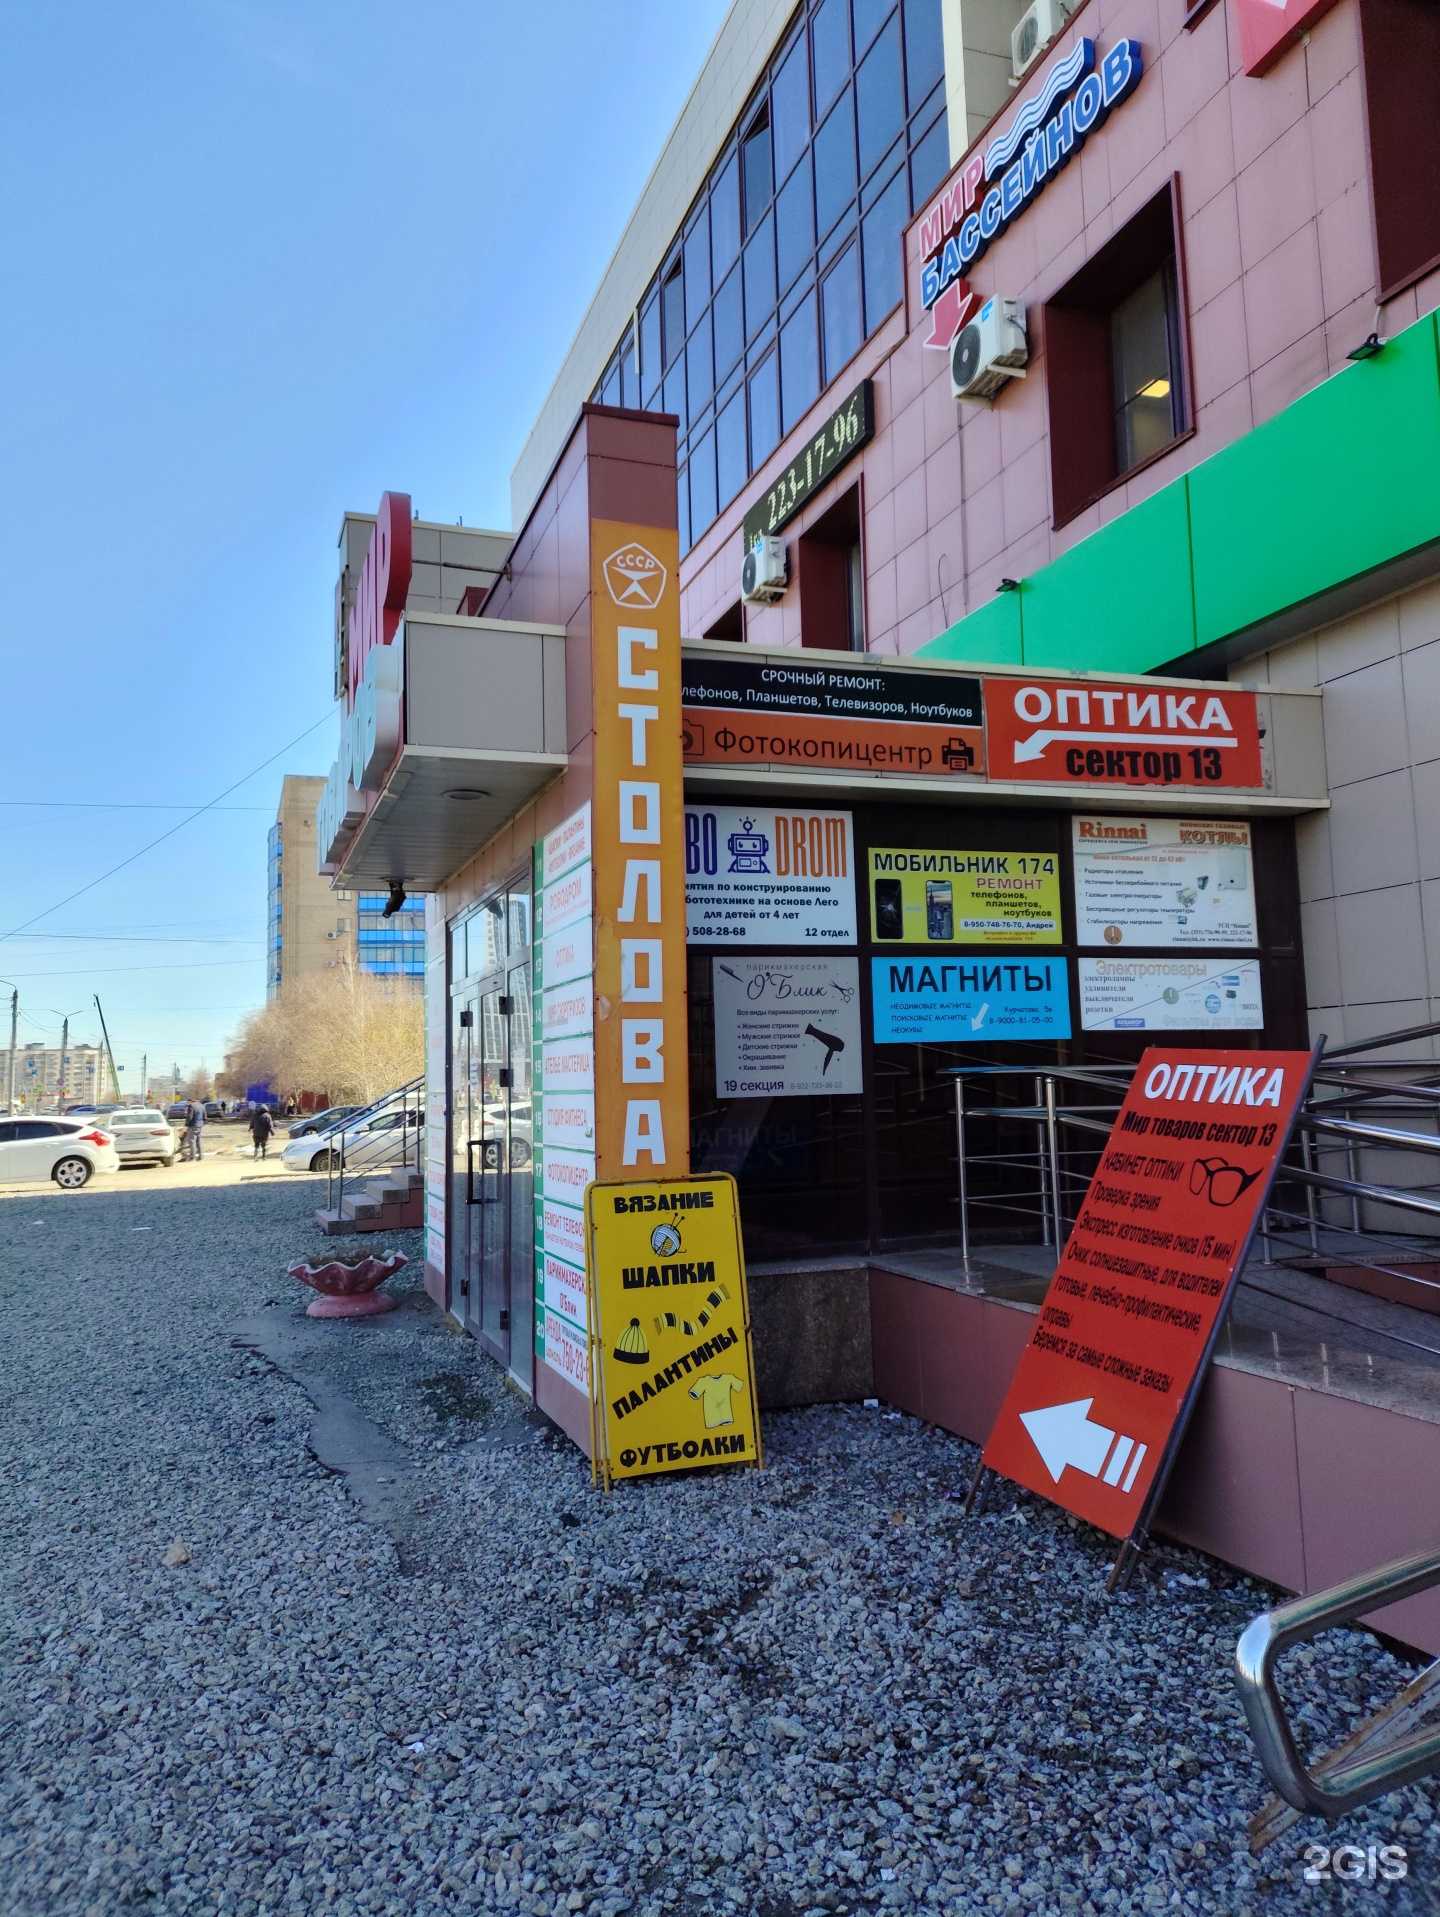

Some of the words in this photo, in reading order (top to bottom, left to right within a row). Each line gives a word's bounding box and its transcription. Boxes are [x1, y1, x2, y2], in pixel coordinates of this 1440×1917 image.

[921, 38, 1141, 310] БАССЕЙНОВ
[919, 155, 984, 263] МИР
[766, 396, 859, 531] 223-17-96
[616, 554, 656, 568] СССР
[761, 669, 825, 686] СРОЧНЫЙ
[829, 675, 886, 691] РЕМОНТ:
[682, 684, 742, 702] лефонов,
[746, 689, 822, 708] Планшетов,
[825, 695, 908, 714] Телевизоров,
[911, 702, 973, 718] Ноутбуков
[1014, 687, 1232, 730] ОПТИКА
[714, 727, 932, 769] Фотокопицентр
[1066, 748, 1181, 783] сектор
[1188, 748, 1222, 780] 13
[1079, 821, 1148, 839] Rinnai
[1179, 830, 1248, 845] КОТЛЫ
[685, 812, 718, 875] BO
[874, 854, 1008, 874] МОБИЛЬНИК
[1018, 858, 1054, 874] 174
[733, 884, 831, 894] конструированию
[970, 891, 1027, 900] телефонов,
[976, 877, 1043, 890] РЕМОНТ
[685, 895, 754, 905] бототехнике
[774, 898, 812, 906] основе
[814, 897, 838, 906] Лего
[985, 900, 1041, 909] планшетов,
[1003, 909, 1052, 918] ноутбуков
[704, 911, 722, 919] для
[725, 909, 756, 919] детей
[759, 911, 770, 919] от
[773, 910, 780, 918] 4
[782, 911, 800, 919] лет
[692, 927, 746, 936] 508-28-68
[805, 928, 818, 936] 12
[821, 929, 849, 937] отдел
[889, 965, 1050, 992] МАГНИТЫ
[724, 1080, 738, 1092] 19
[740, 1081, 784, 1092] секция
[1145, 1063, 1284, 1106] ОПТИКА
[1121, 1110, 1151, 1135] Мир
[1151, 1118, 1207, 1140] товаров
[1206, 1122, 1258, 1147] сектор
[1258, 1124, 1277, 1147] 13
[1104, 1152, 1146, 1174] КАБИНЕТ
[1144, 1158, 1184, 1180] ОПТИКИ
[614, 1192, 714, 1214] ВЯЗАНИЕ
[1091, 1181, 1131, 1206] Проверка
[1130, 1193, 1161, 1210] зрения
[1080, 1210, 1118, 1236] Экспресс
[547, 1259, 586, 1295] ПАРИКМАХЕРСК
[622, 1261, 715, 1289] ШАПКИ
[536, 1320, 544, 1338] 20
[612, 1327, 739, 1420] ПАЛАНТИНЫ
[620, 1434, 745, 1468] ФУТБОЛКИ
